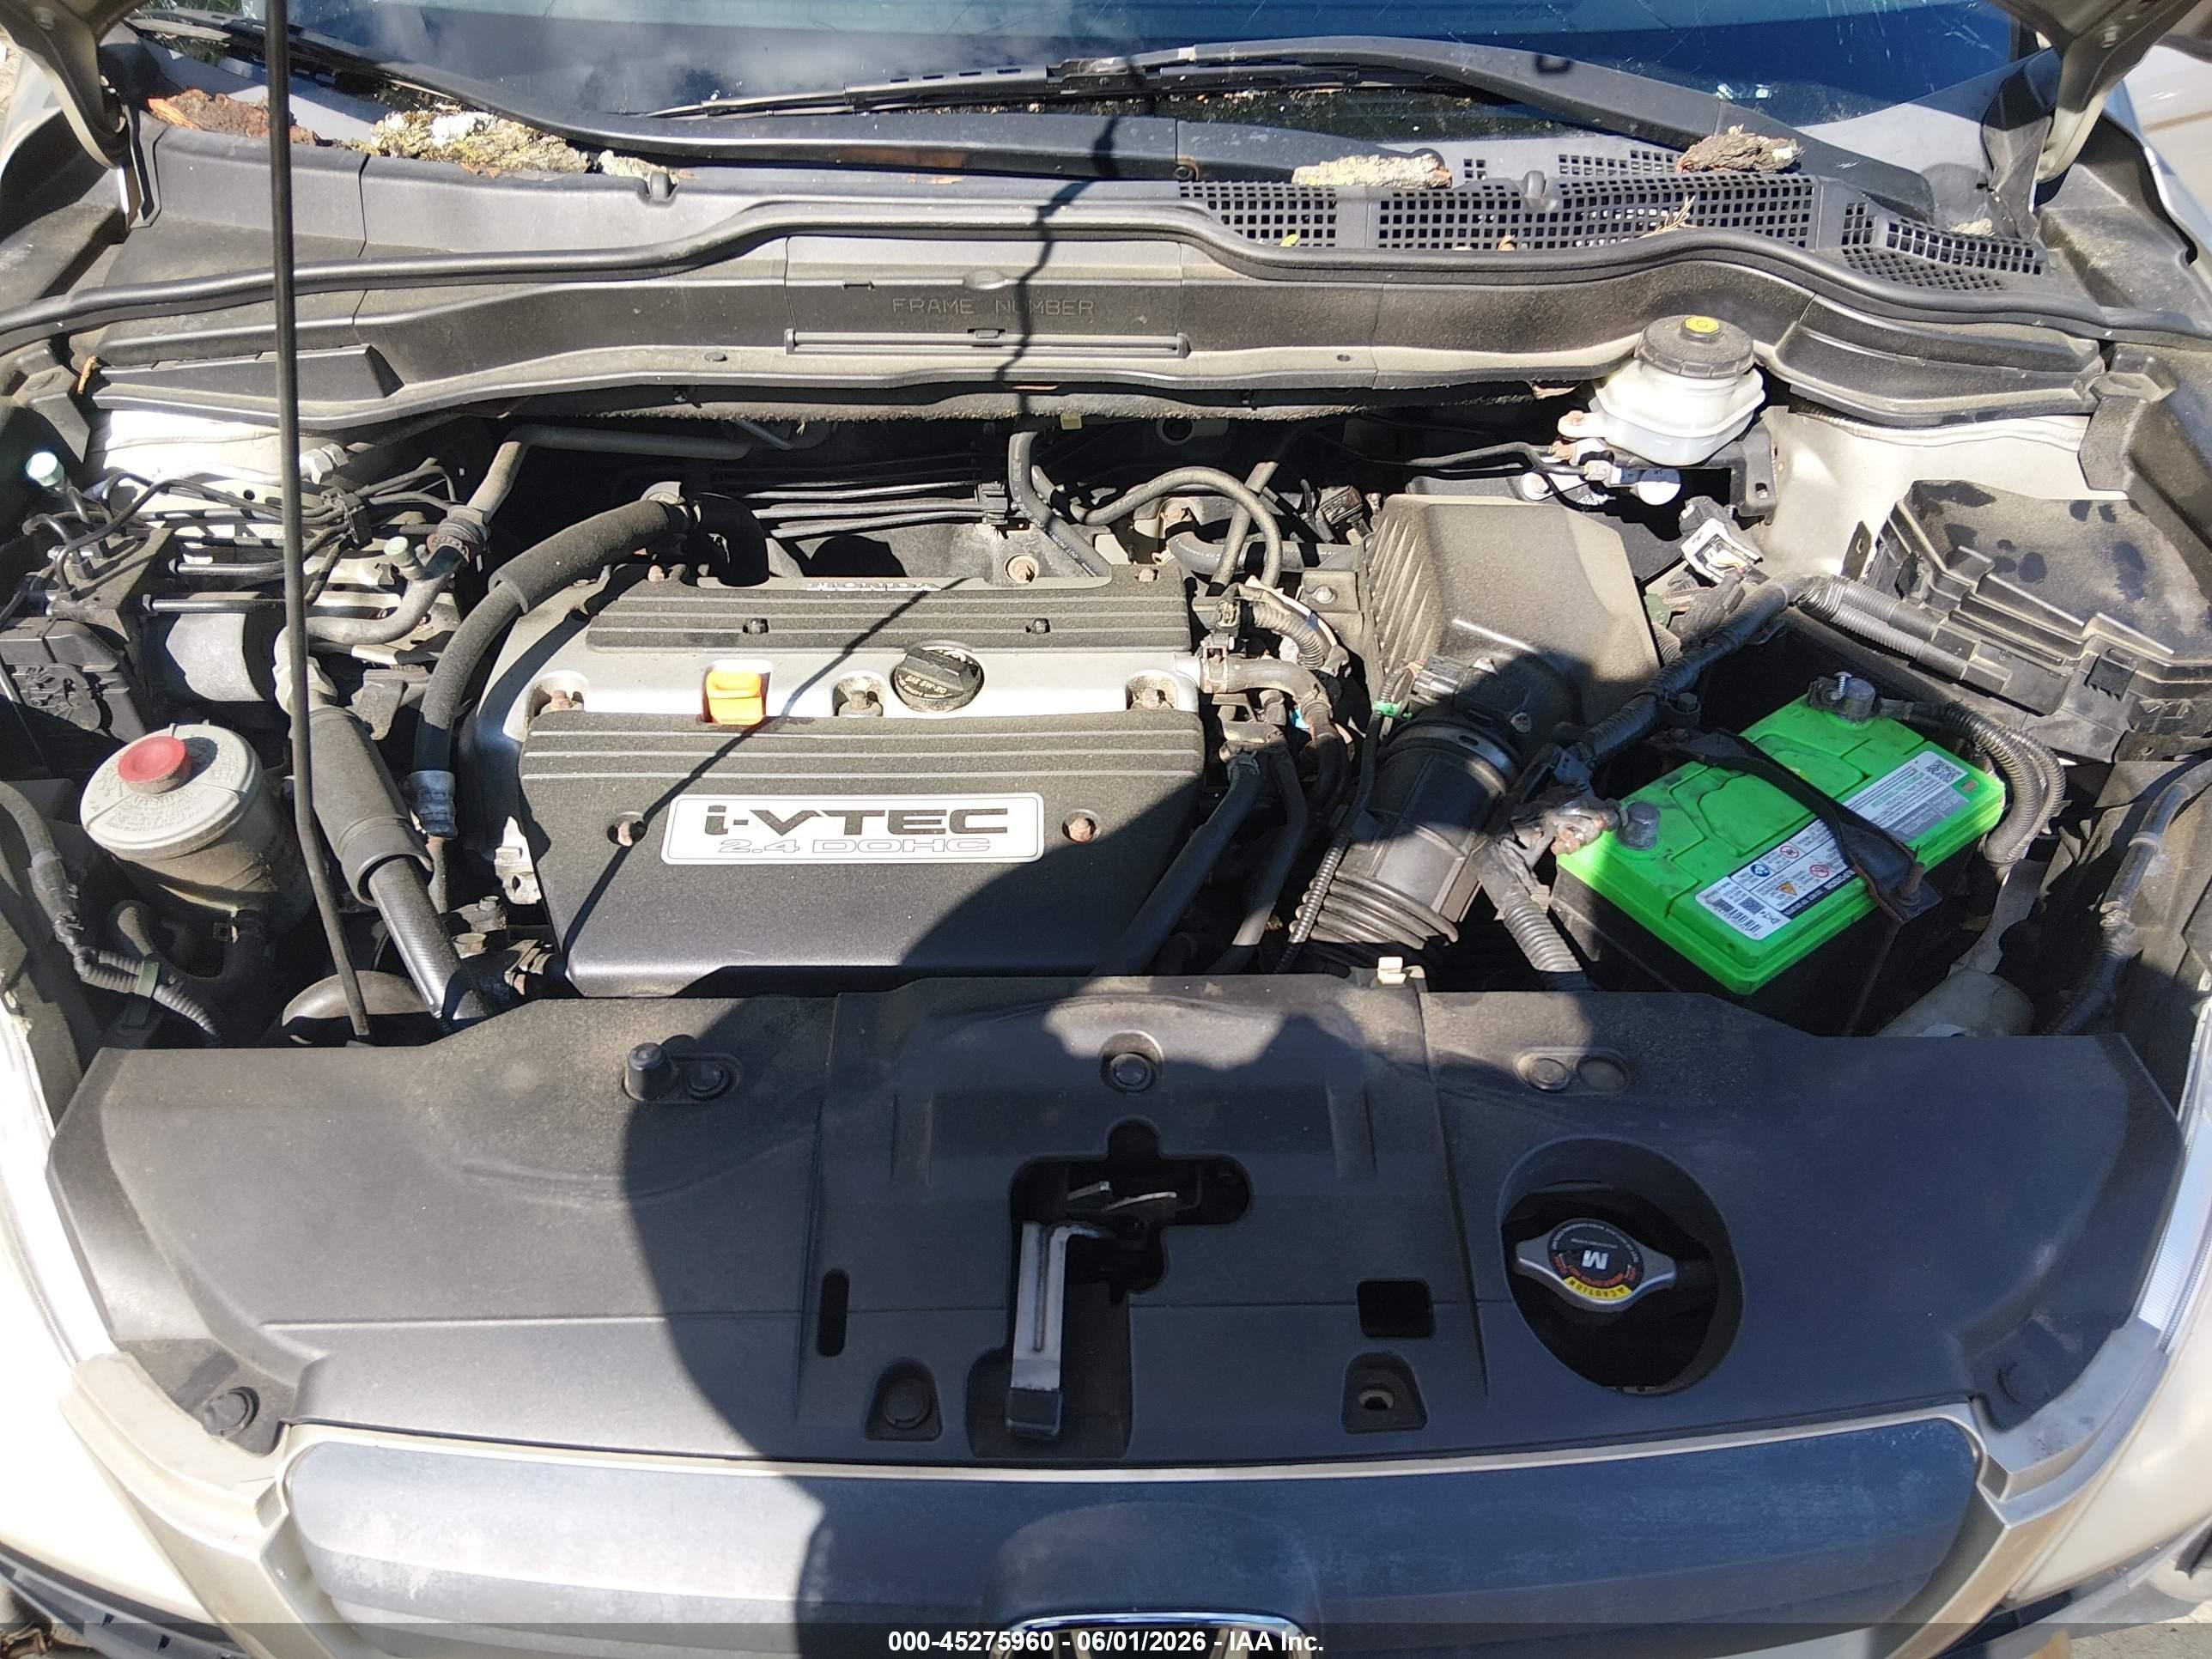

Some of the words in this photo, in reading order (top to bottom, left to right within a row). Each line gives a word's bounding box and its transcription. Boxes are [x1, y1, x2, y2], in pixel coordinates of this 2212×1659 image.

[892, 298, 975, 315] FRAME
[920, 680, 948, 694] 5W-20
[704, 805, 1009, 836] i-VTEC
[718, 838, 800, 854] 2.4
[811, 837, 991, 854] DOHC
[1569, 1279, 1618, 1297] CAUTION
